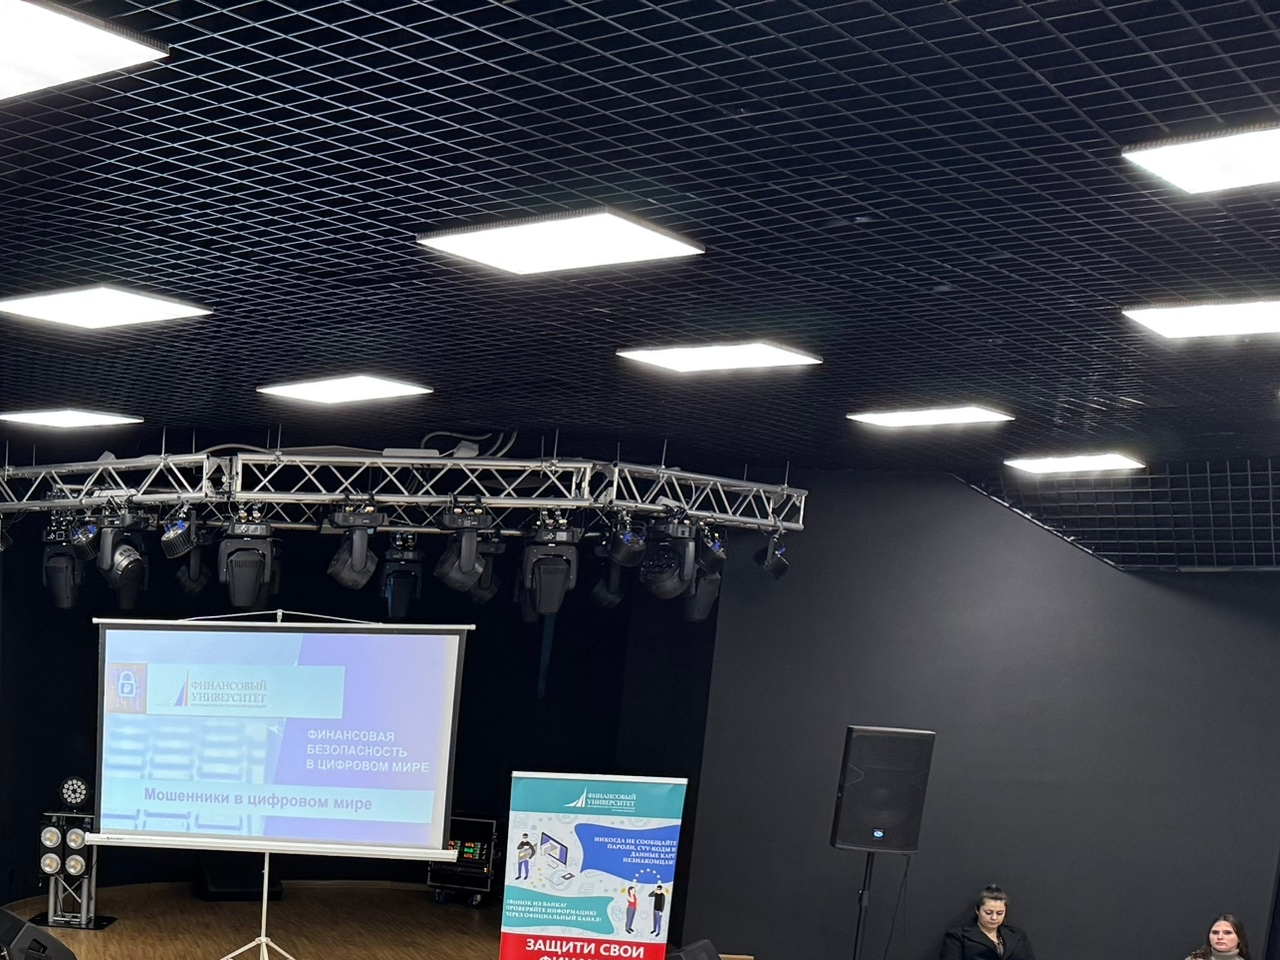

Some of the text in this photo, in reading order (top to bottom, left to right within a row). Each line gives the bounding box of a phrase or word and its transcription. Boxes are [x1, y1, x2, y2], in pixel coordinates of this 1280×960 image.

[191, 680, 267, 690] ФИНАНСОВЫЙ
[191, 693, 266, 702] УНИВЕРСИТЕТ
[307, 730, 394, 742] ФИНАНСОВАЯ
[307, 744, 408, 757] БЕЗОПАСНОСТЬ
[306, 759, 430, 772] В ЦИФРОВОМ МИРЕ
[144, 787, 372, 812] Мошенники в цифровом мире
[526, 938, 645, 958] ЗАЩИТИ СВОИ
